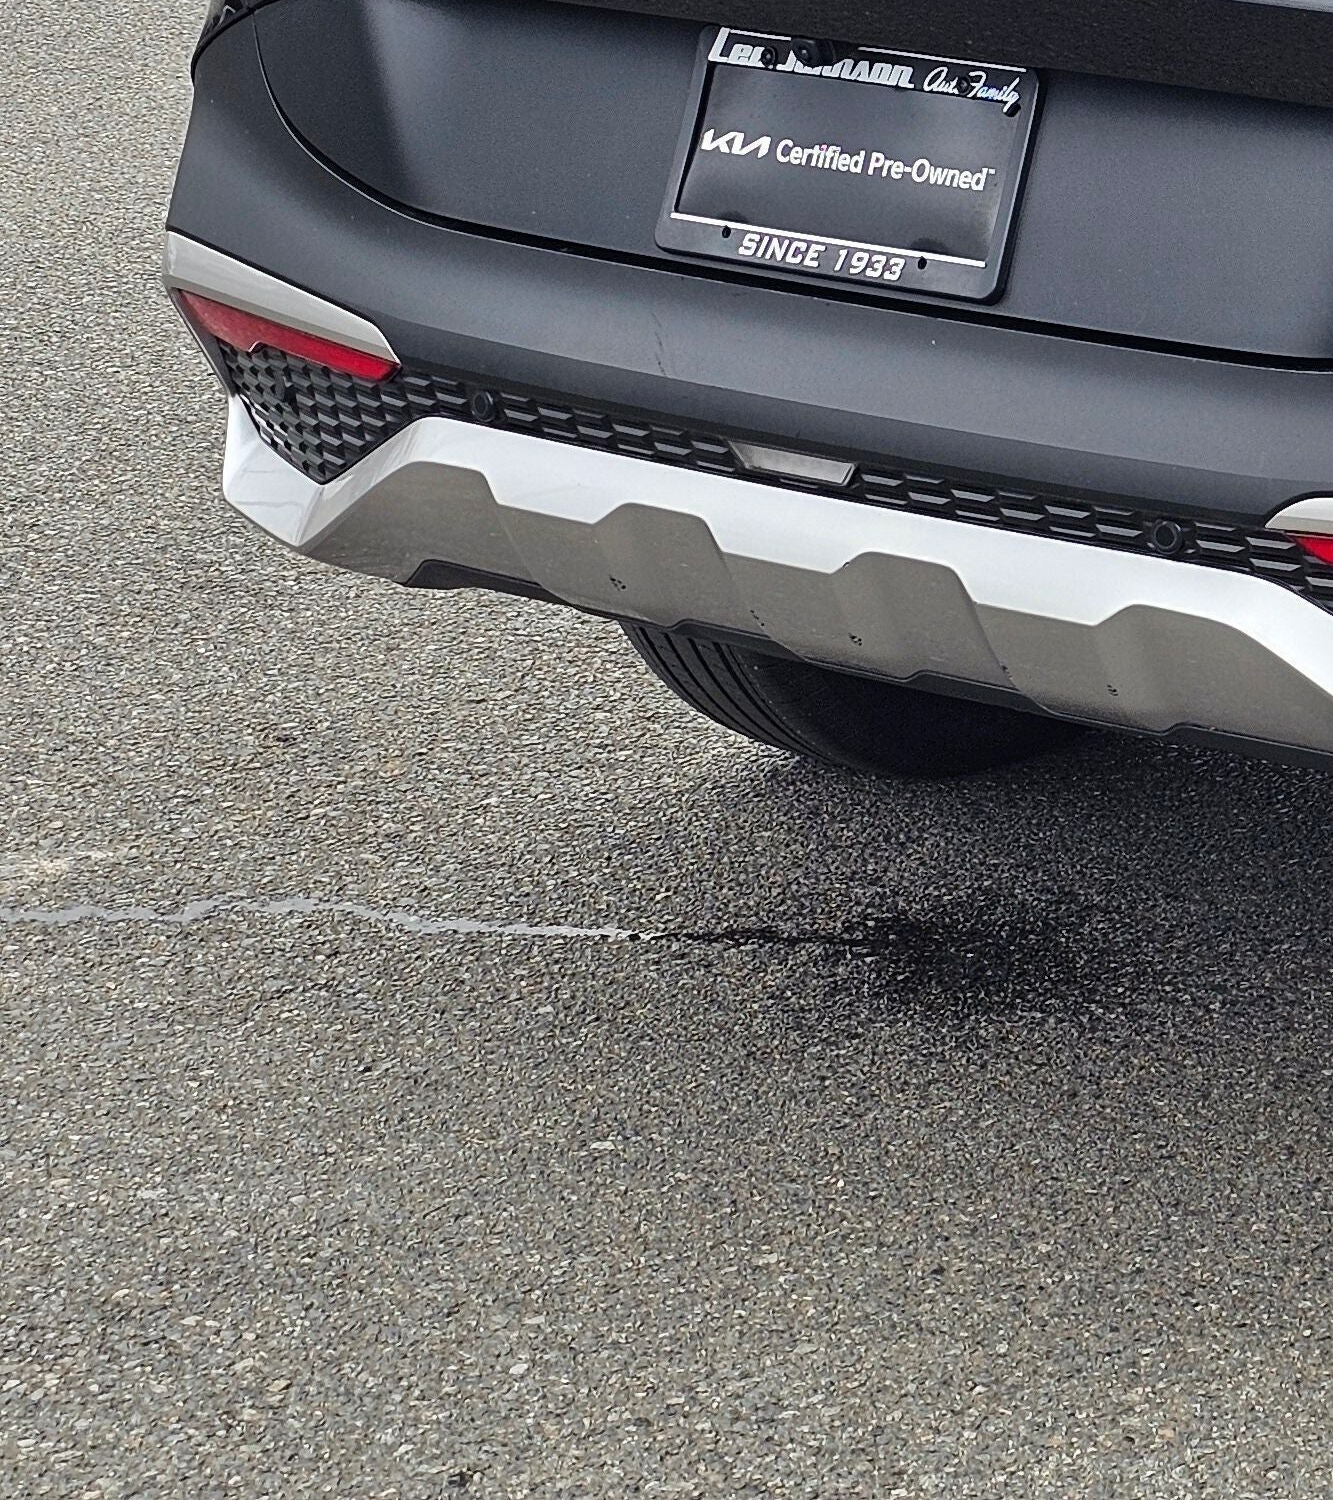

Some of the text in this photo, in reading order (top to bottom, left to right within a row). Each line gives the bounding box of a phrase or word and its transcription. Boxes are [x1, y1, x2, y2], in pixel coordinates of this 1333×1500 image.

[967, 70, 1020, 112] Family
[700, 128, 772, 158] KIA
[776, 138, 865, 175] Certified
[738, 232, 906, 281] SINCE 1933
